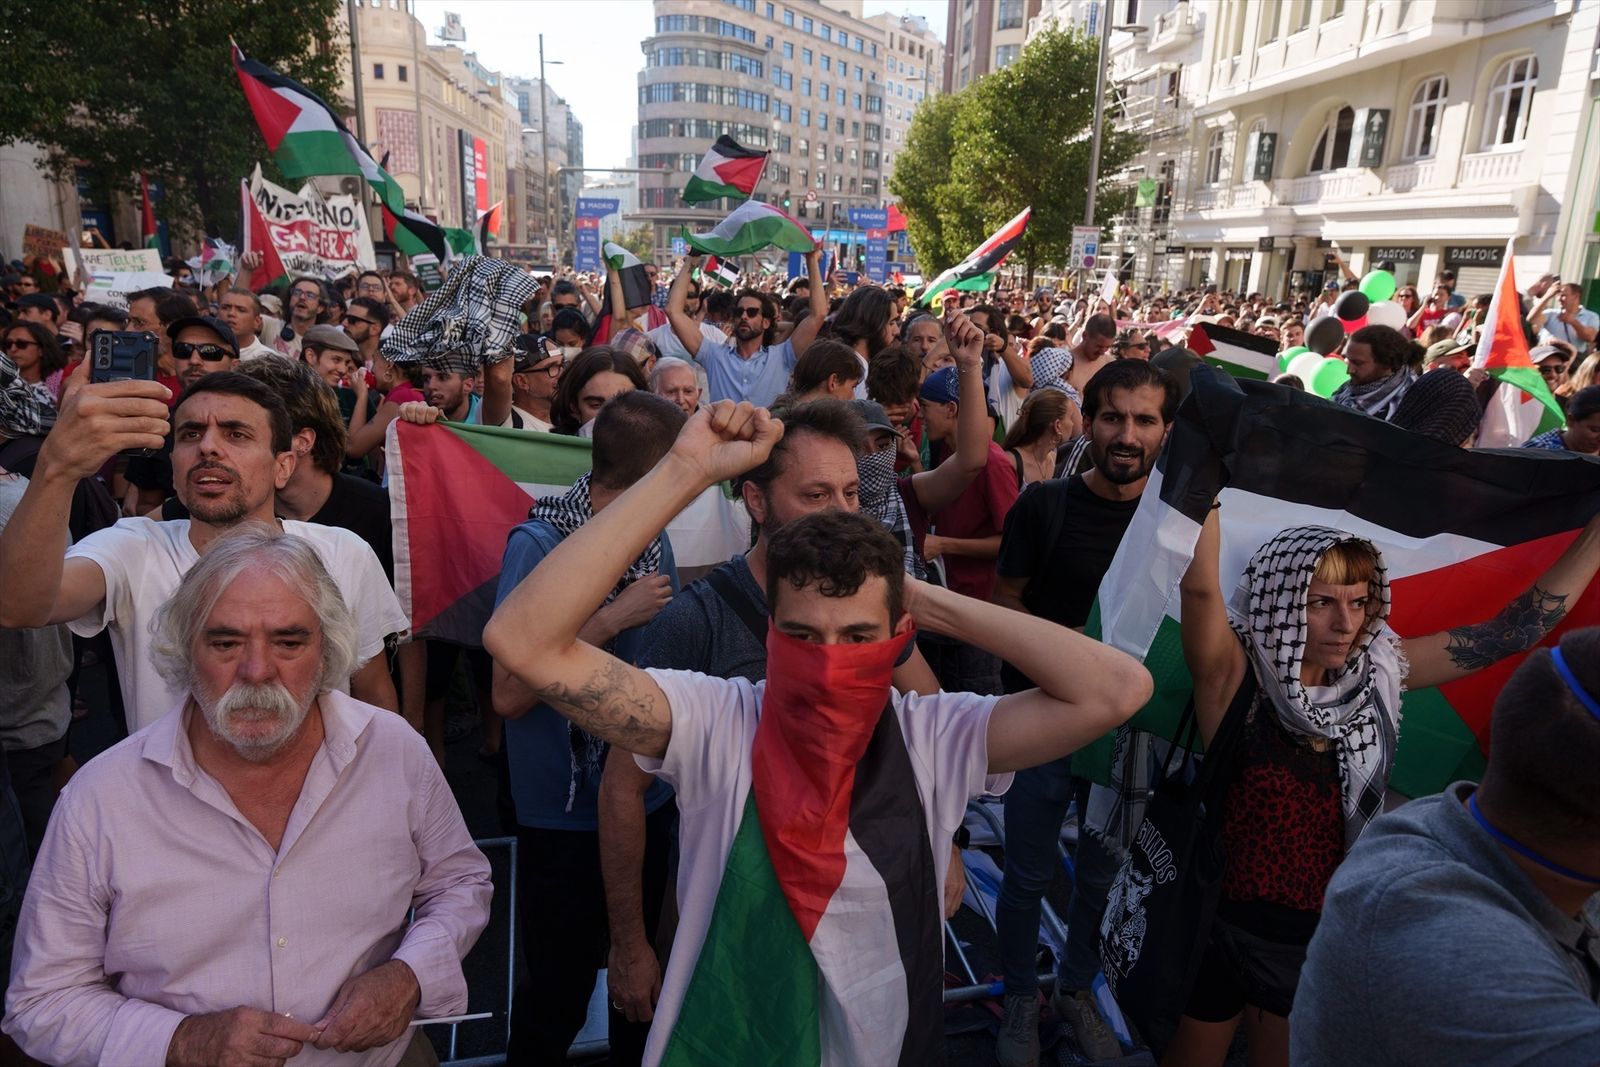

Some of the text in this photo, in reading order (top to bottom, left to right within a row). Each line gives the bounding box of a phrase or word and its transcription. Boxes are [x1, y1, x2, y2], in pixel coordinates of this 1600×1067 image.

[588, 202, 614, 210] MADRID
[676, 241, 684, 252] P
[1451, 249, 1498, 261] PARFOIS
[107, 289, 129, 299] CON
